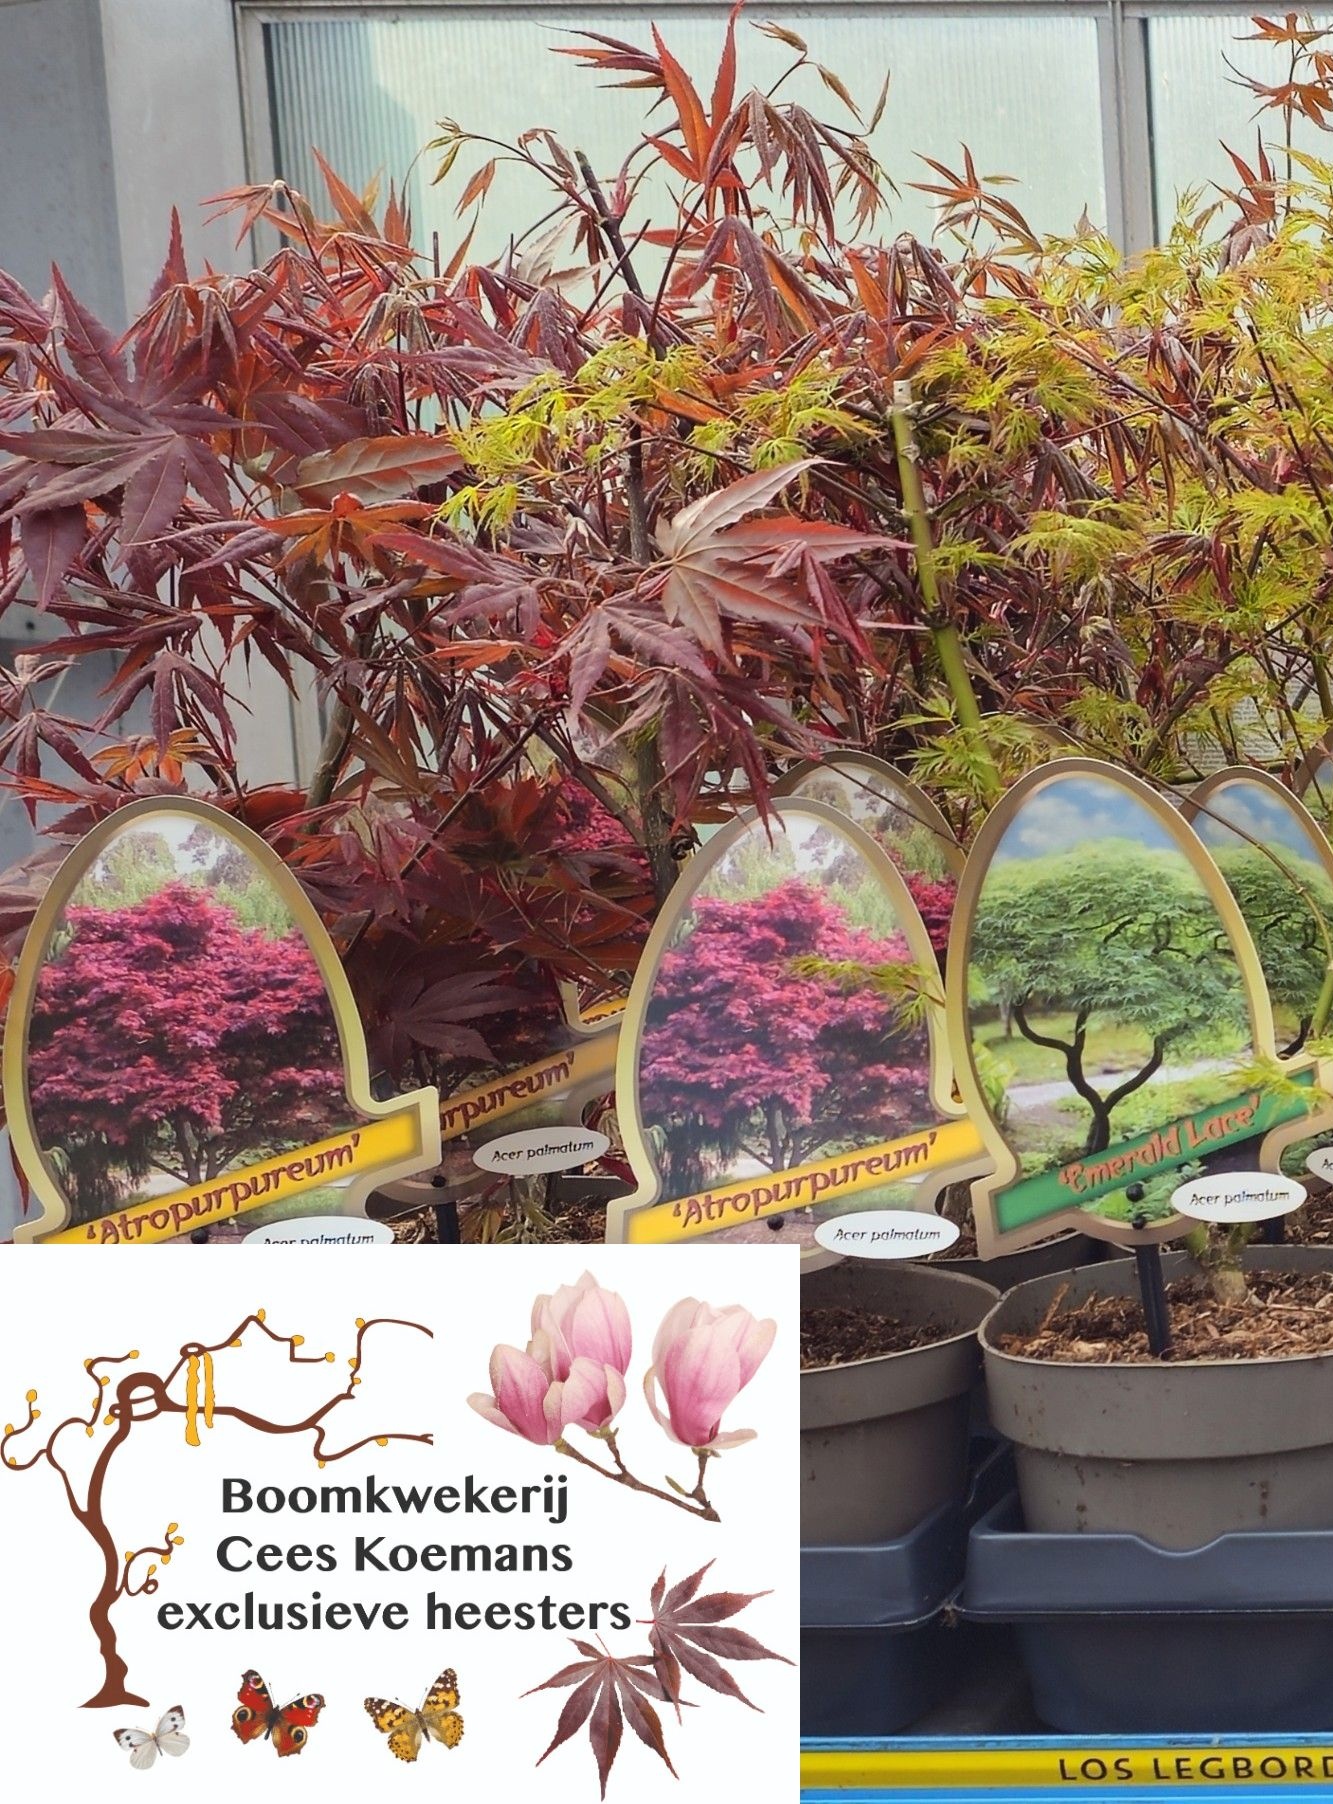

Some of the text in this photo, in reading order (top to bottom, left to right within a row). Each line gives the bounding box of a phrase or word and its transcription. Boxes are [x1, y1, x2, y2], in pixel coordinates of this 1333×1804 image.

[440, 1051, 575, 1130] rpureum'
[491, 1140, 594, 1163] Acer palmatum
[1059, 1094, 1261, 1194] 'Emerald Lace'
[672, 1131, 938, 1228] 'Atropurpureum'
[1189, 1189, 1290, 1207] Acer palmatum
[833, 1228, 941, 1243] Acer palmatum
[1059, 1757, 1134, 1783] LOS
